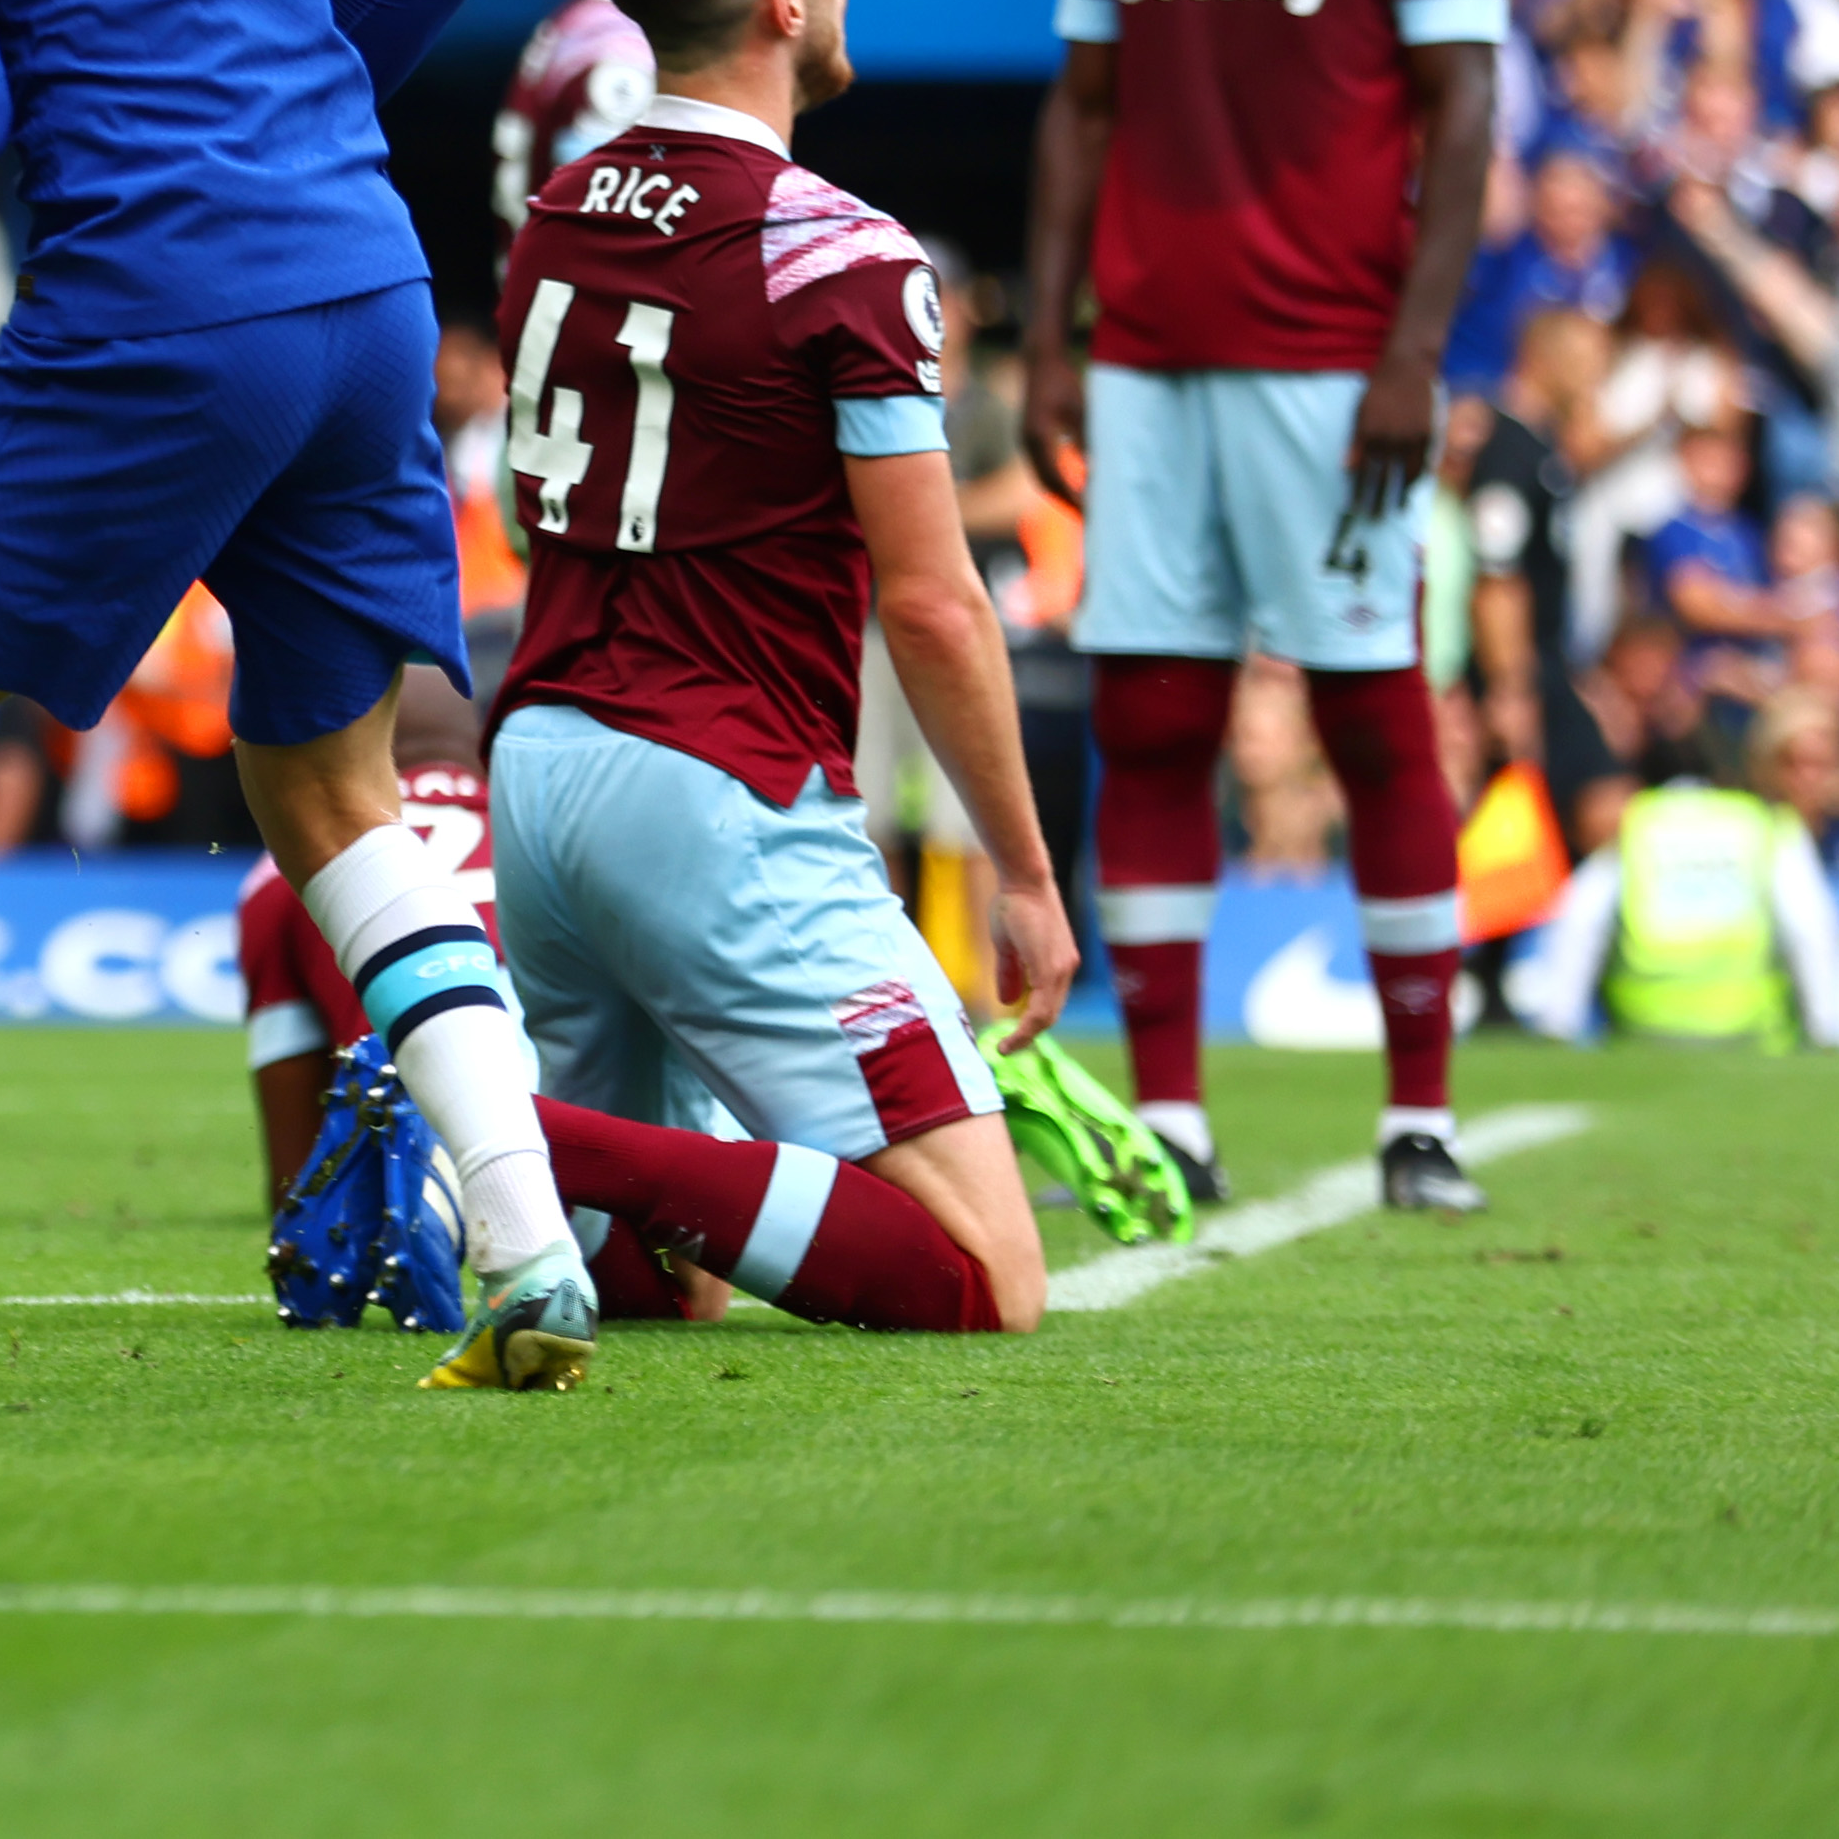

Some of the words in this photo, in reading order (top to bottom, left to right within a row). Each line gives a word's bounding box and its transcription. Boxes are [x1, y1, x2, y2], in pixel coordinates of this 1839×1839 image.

[579, 166, 701, 237] RICE
[507, 278, 673, 554] 41
[415, 954, 490, 980] CFC
